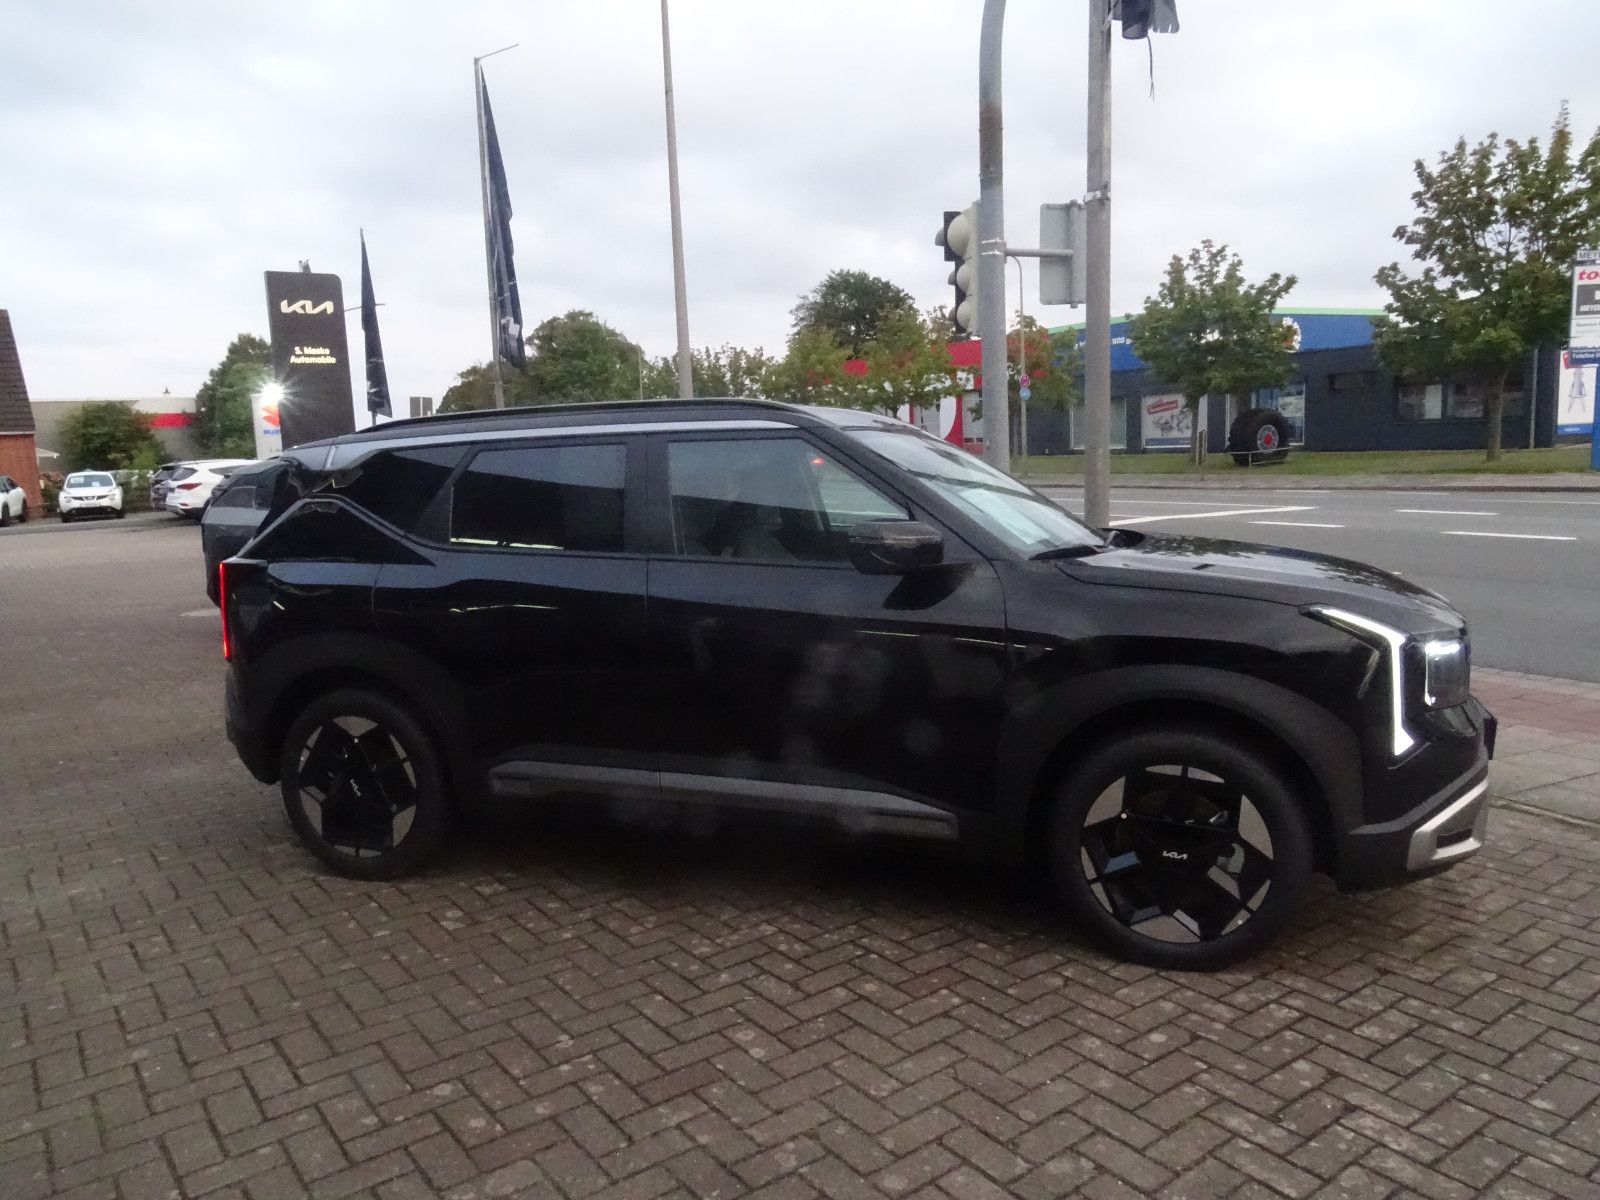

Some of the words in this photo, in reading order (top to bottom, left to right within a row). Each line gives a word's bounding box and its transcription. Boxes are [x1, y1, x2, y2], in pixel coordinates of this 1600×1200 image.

[1579, 270, 1600, 280] to
[281, 300, 334, 314] KIA
[290, 355, 336, 364] Automobile
[1162, 850, 1188, 860] KIA
